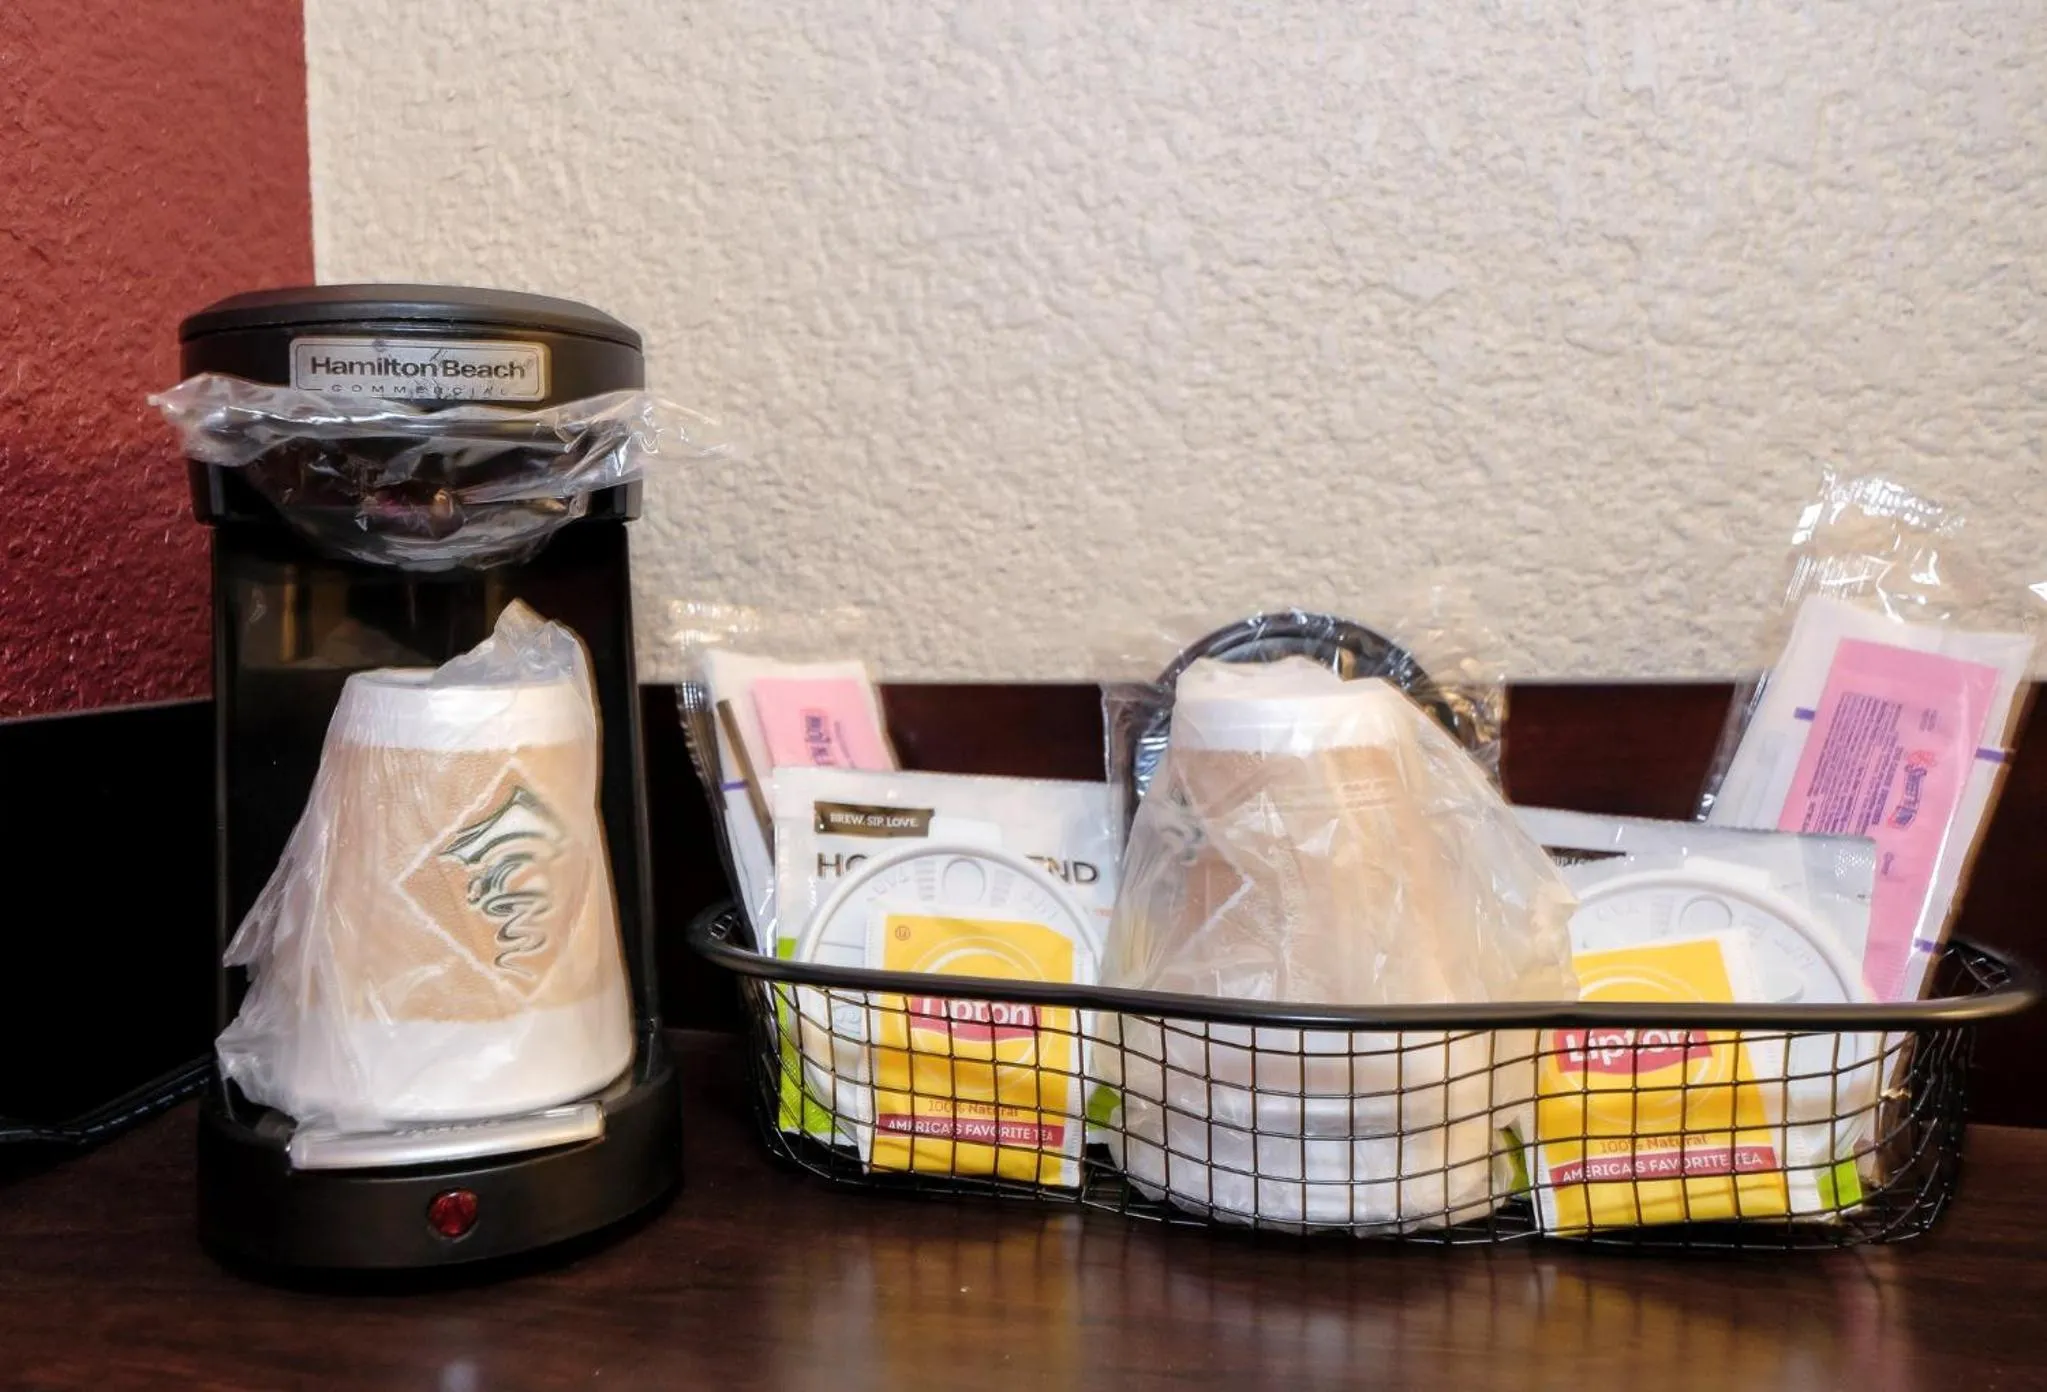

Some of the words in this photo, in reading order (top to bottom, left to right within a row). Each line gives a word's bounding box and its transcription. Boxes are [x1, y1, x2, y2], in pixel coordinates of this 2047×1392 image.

[311, 356, 437, 378] Hamilton
[442, 360, 526, 379] Beach
[331, 384, 509, 395] COMMERCIAL
[922, 998, 1030, 1028] pton
[968, 1103, 1019, 1118] Natral
[888, 1119, 962, 1135] AMRICA'S
[1563, 1160, 1646, 1182] AMERICAS
